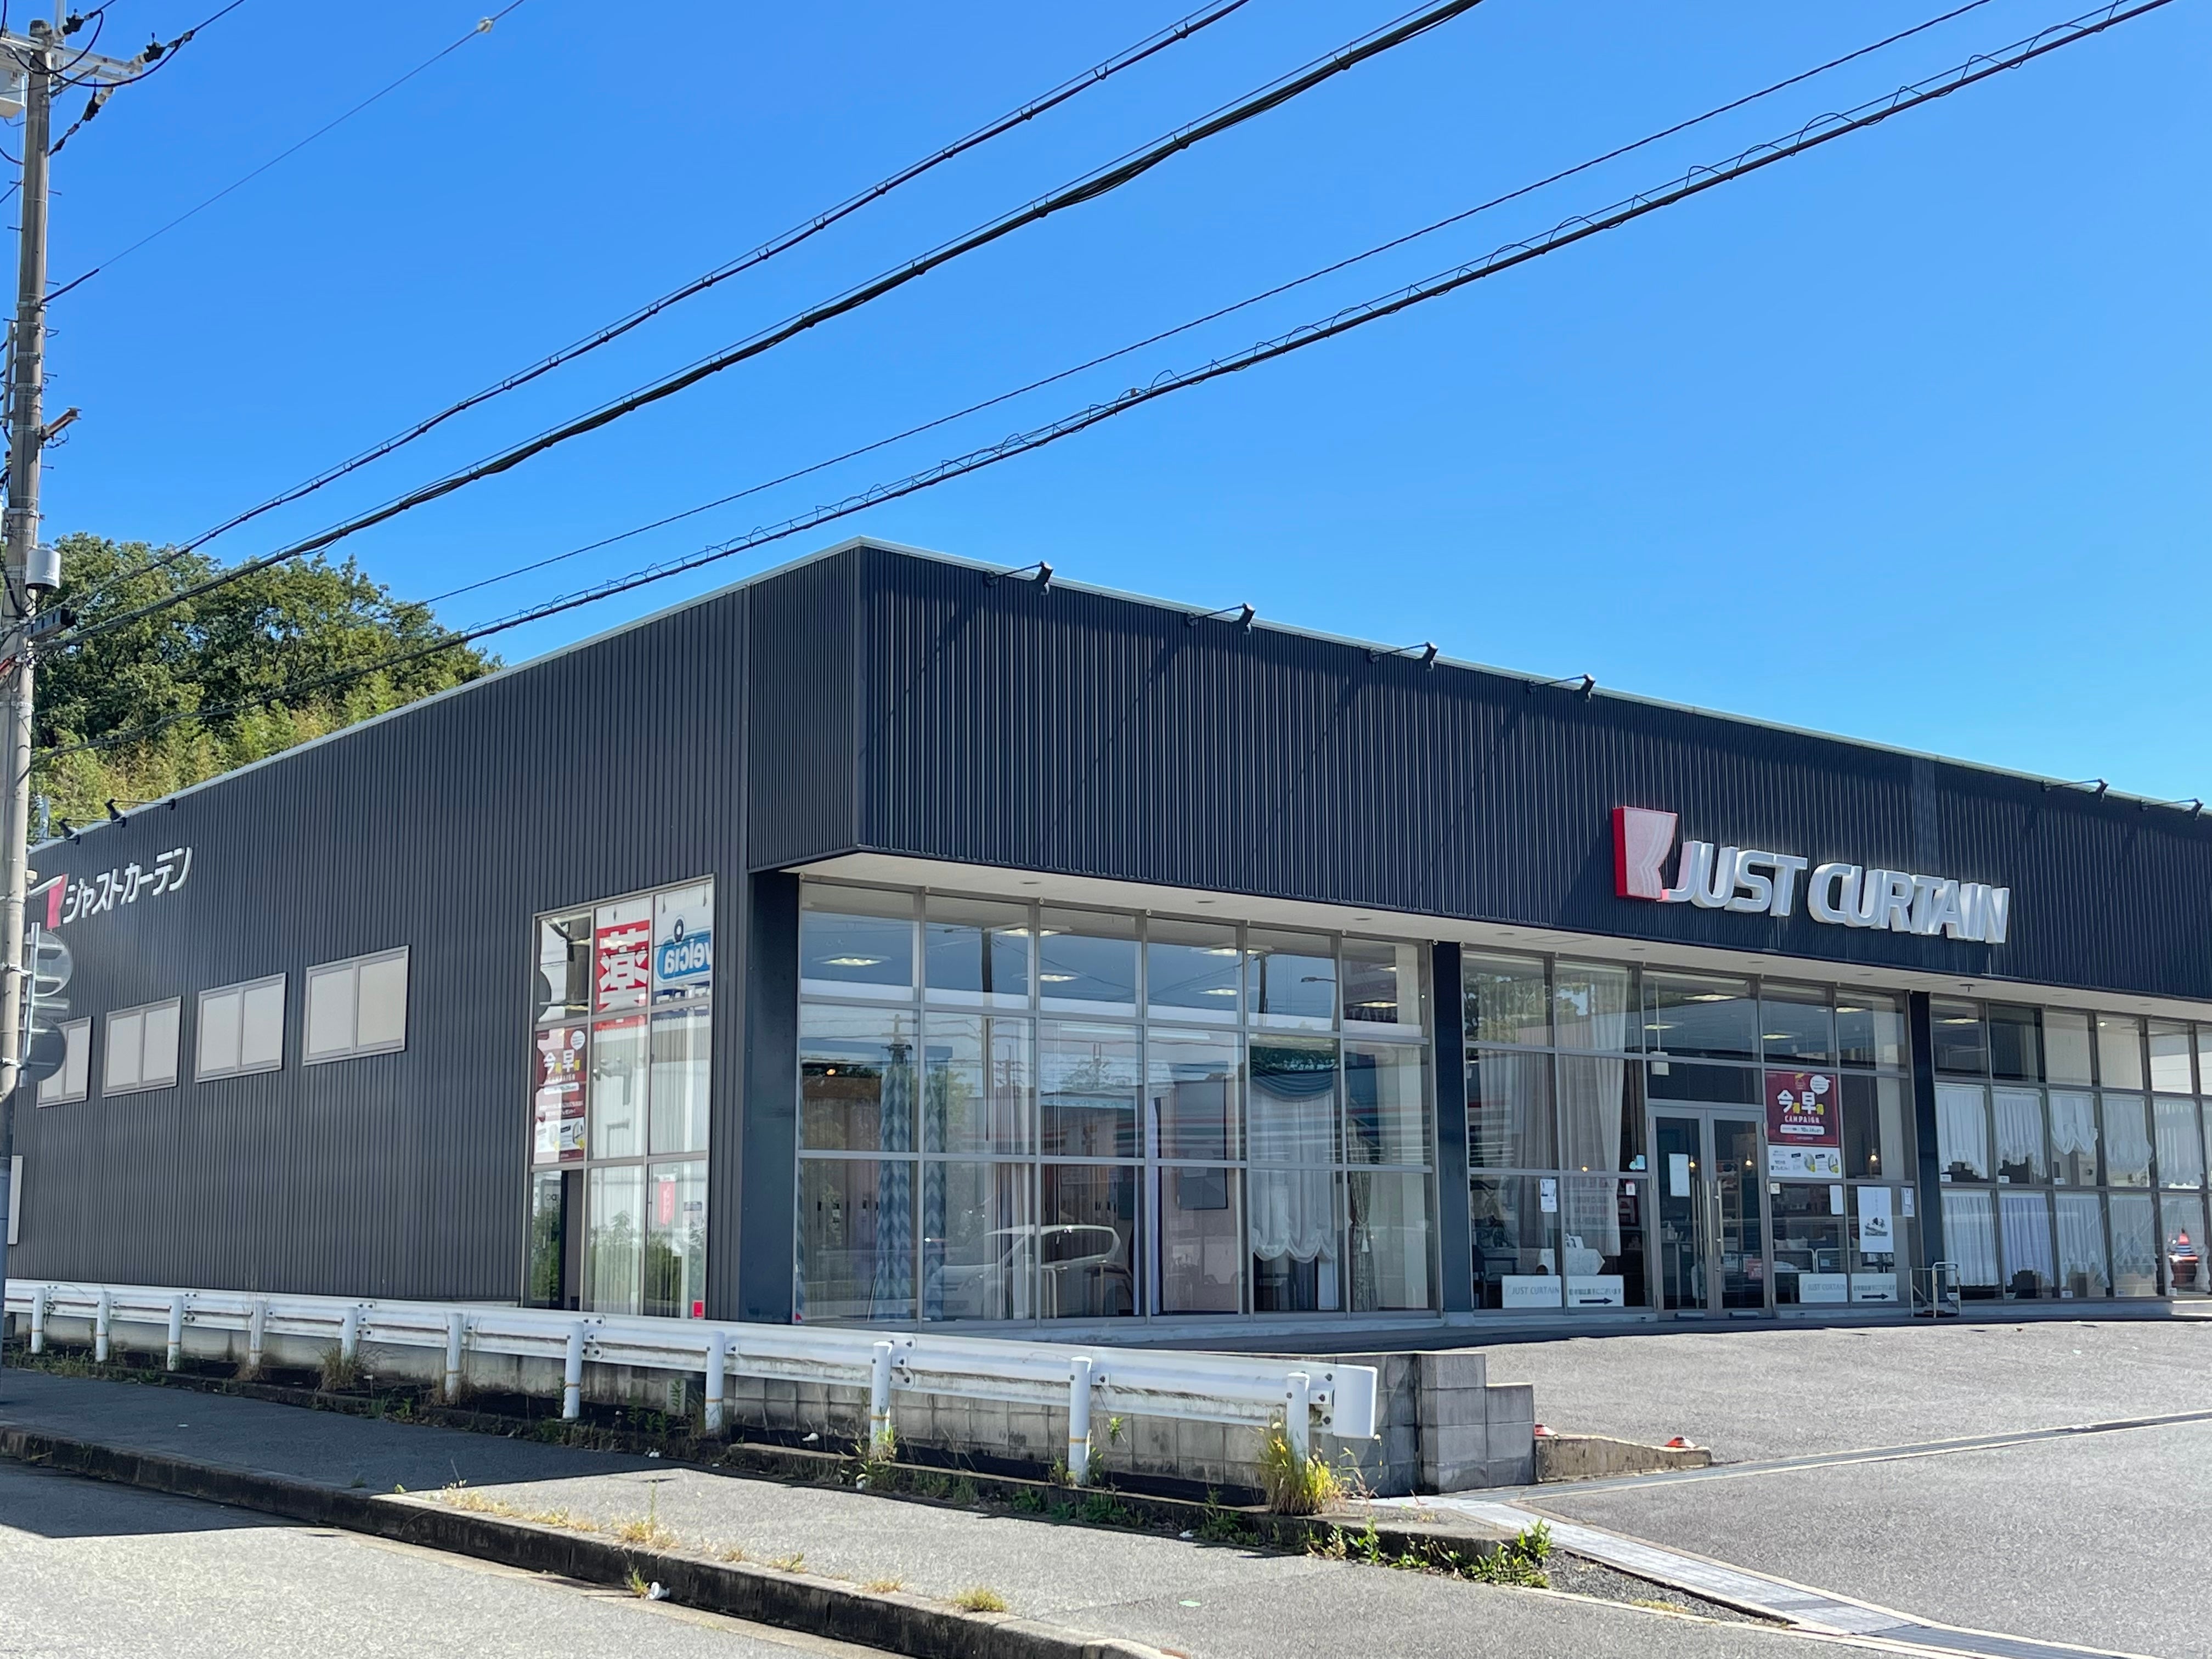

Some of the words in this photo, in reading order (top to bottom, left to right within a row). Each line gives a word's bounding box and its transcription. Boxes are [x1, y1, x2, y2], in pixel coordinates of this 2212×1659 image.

[63, 846, 193, 924] ジャストカーテン
[1660, 840, 1808, 917] JUST
[1808, 862, 2010, 944] CURTAIN
